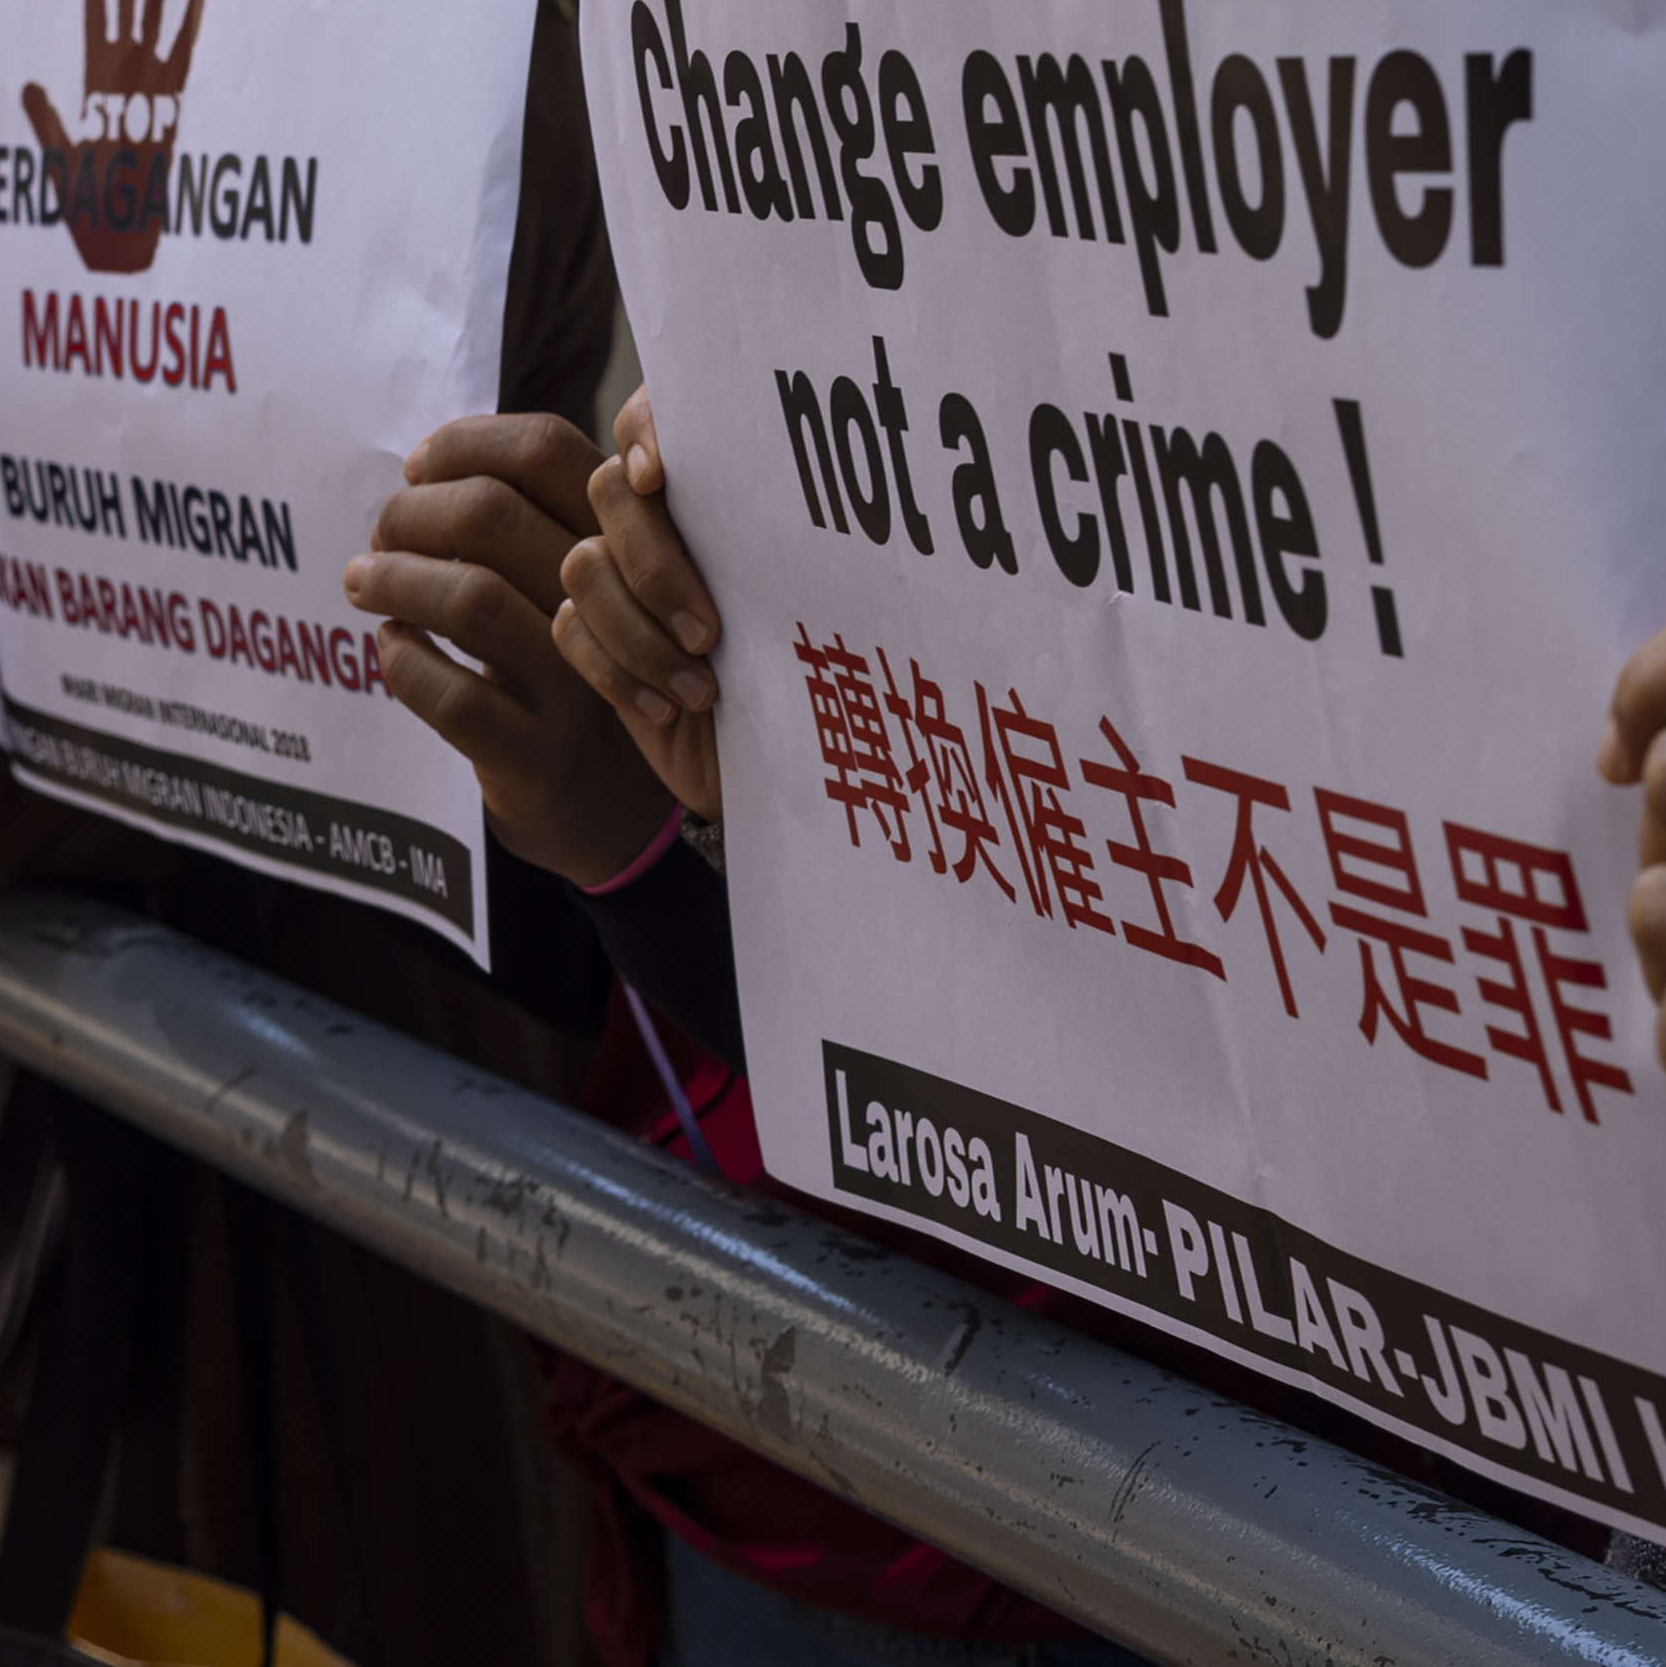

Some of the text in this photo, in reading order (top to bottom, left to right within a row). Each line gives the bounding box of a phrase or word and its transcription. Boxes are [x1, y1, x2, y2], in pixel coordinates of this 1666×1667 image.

[81, 91, 178, 143] STOP
[23, 289, 236, 393] MANUSIA
[0, 454, 299, 572] BURUH MIGRAN
[774, 335, 935, 557] not
[938, 392, 1020, 576] a
[55, 567, 197, 653] BARANG
[199, 598, 394, 698] DAGANGA
[202, 783, 313, 852] INDONESIA
[327, 821, 396, 876] AMCB
[793, 621, 1635, 1126] 轉換僱主不是罪
[835, 1068, 1001, 1222] Larosa
